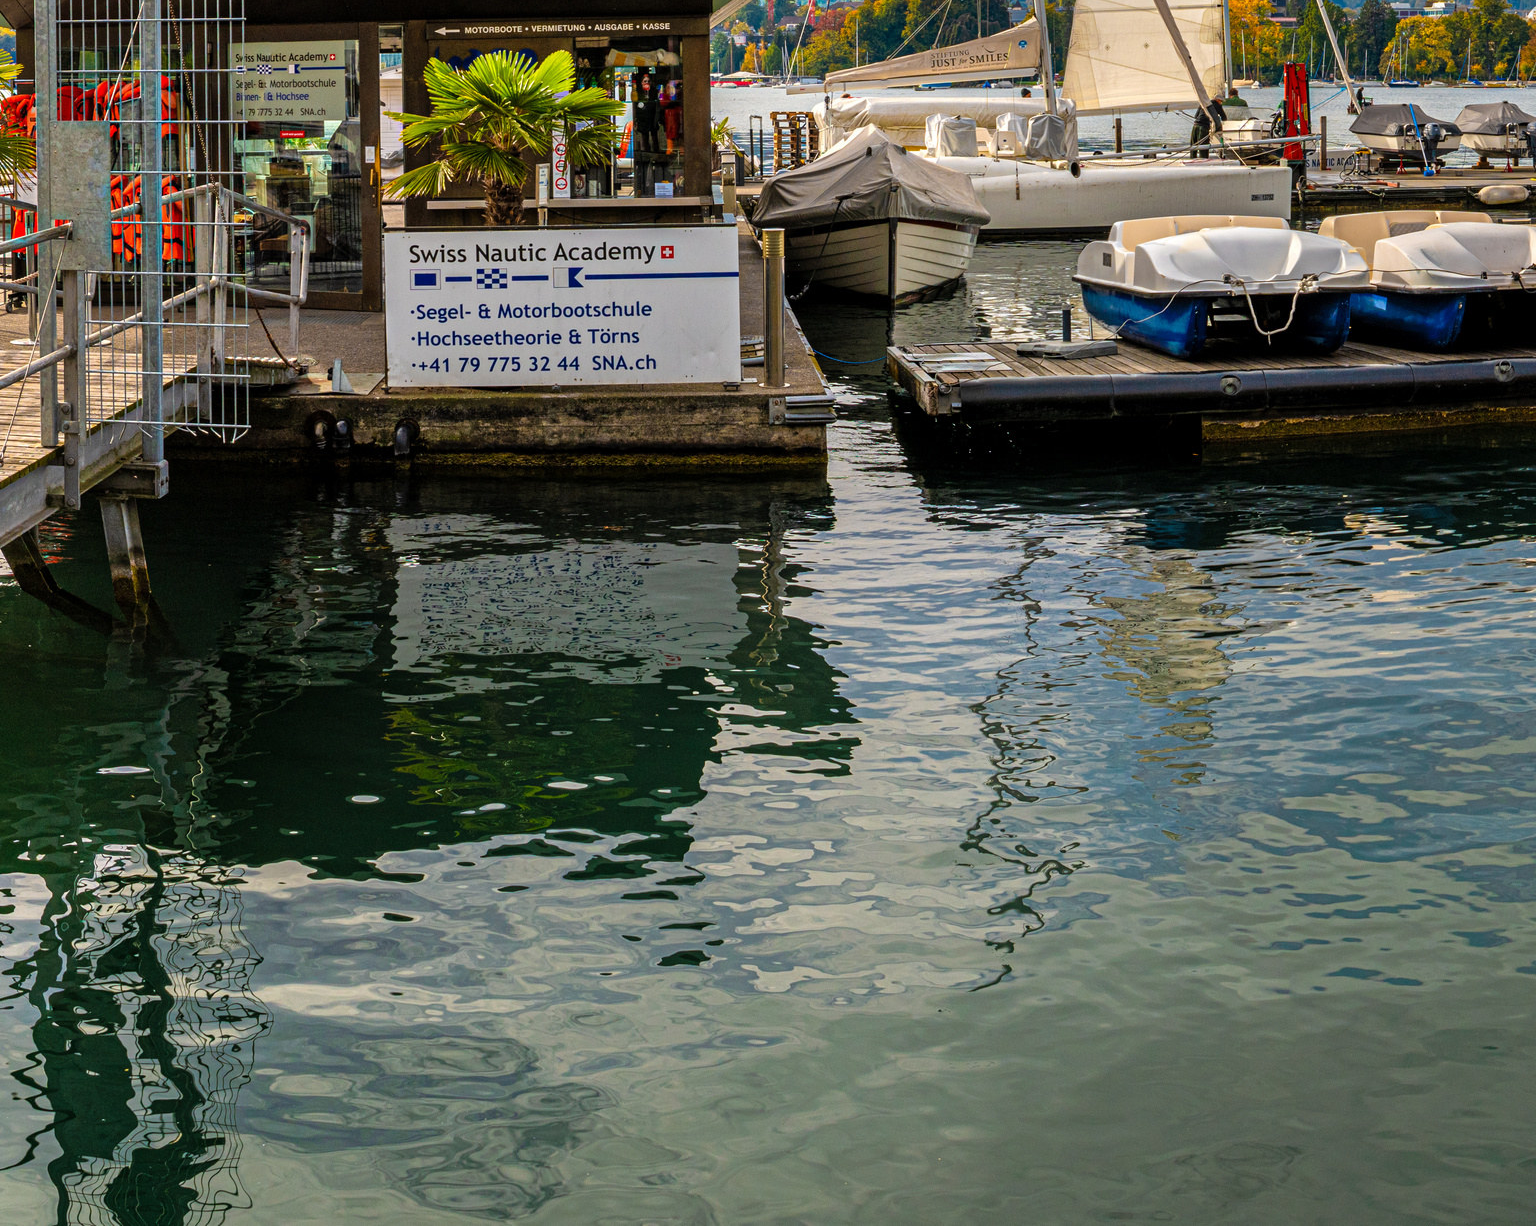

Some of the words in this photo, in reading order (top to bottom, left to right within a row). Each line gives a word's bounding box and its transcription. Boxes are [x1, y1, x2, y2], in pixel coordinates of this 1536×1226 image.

[464, 25, 523, 34] MOTORBOOTE
[531, 24, 586, 33] VERMIETUNG
[594, 23, 634, 31] AUSGABE
[642, 22, 671, 30] KASSE
[289, 52, 328, 62] Academy
[930, 49, 970, 59] STIFTUNG
[931, 58, 956, 68] JUST
[969, 52, 1008, 64] SMILES
[270, 78, 336, 88] Motorbootschule
[267, 92, 273, 100] &
[276, 92, 309, 100] Hochsee
[300, 107, 326, 115] SNA.ch
[1312, 158, 1334, 167] NATIC
[409, 244, 467, 263] Swiss
[475, 243, 546, 262] Nautic
[553, 242, 656, 264] Academy
[417, 303, 471, 323] Segel-
[478, 303, 491, 318] &
[497, 301, 652, 319] Motorbootschule
[417, 329, 562, 346] Hochseetheorie
[569, 329, 582, 344] &
[587, 328, 640, 344] Törns
[418, 357, 450, 372] +41
[459, 357, 480, 372] 79
[488, 356, 521, 371] 775
[529, 356, 551, 371] 32
[557, 356, 580, 371] 44
[592, 354, 657, 371] SNA.ch
